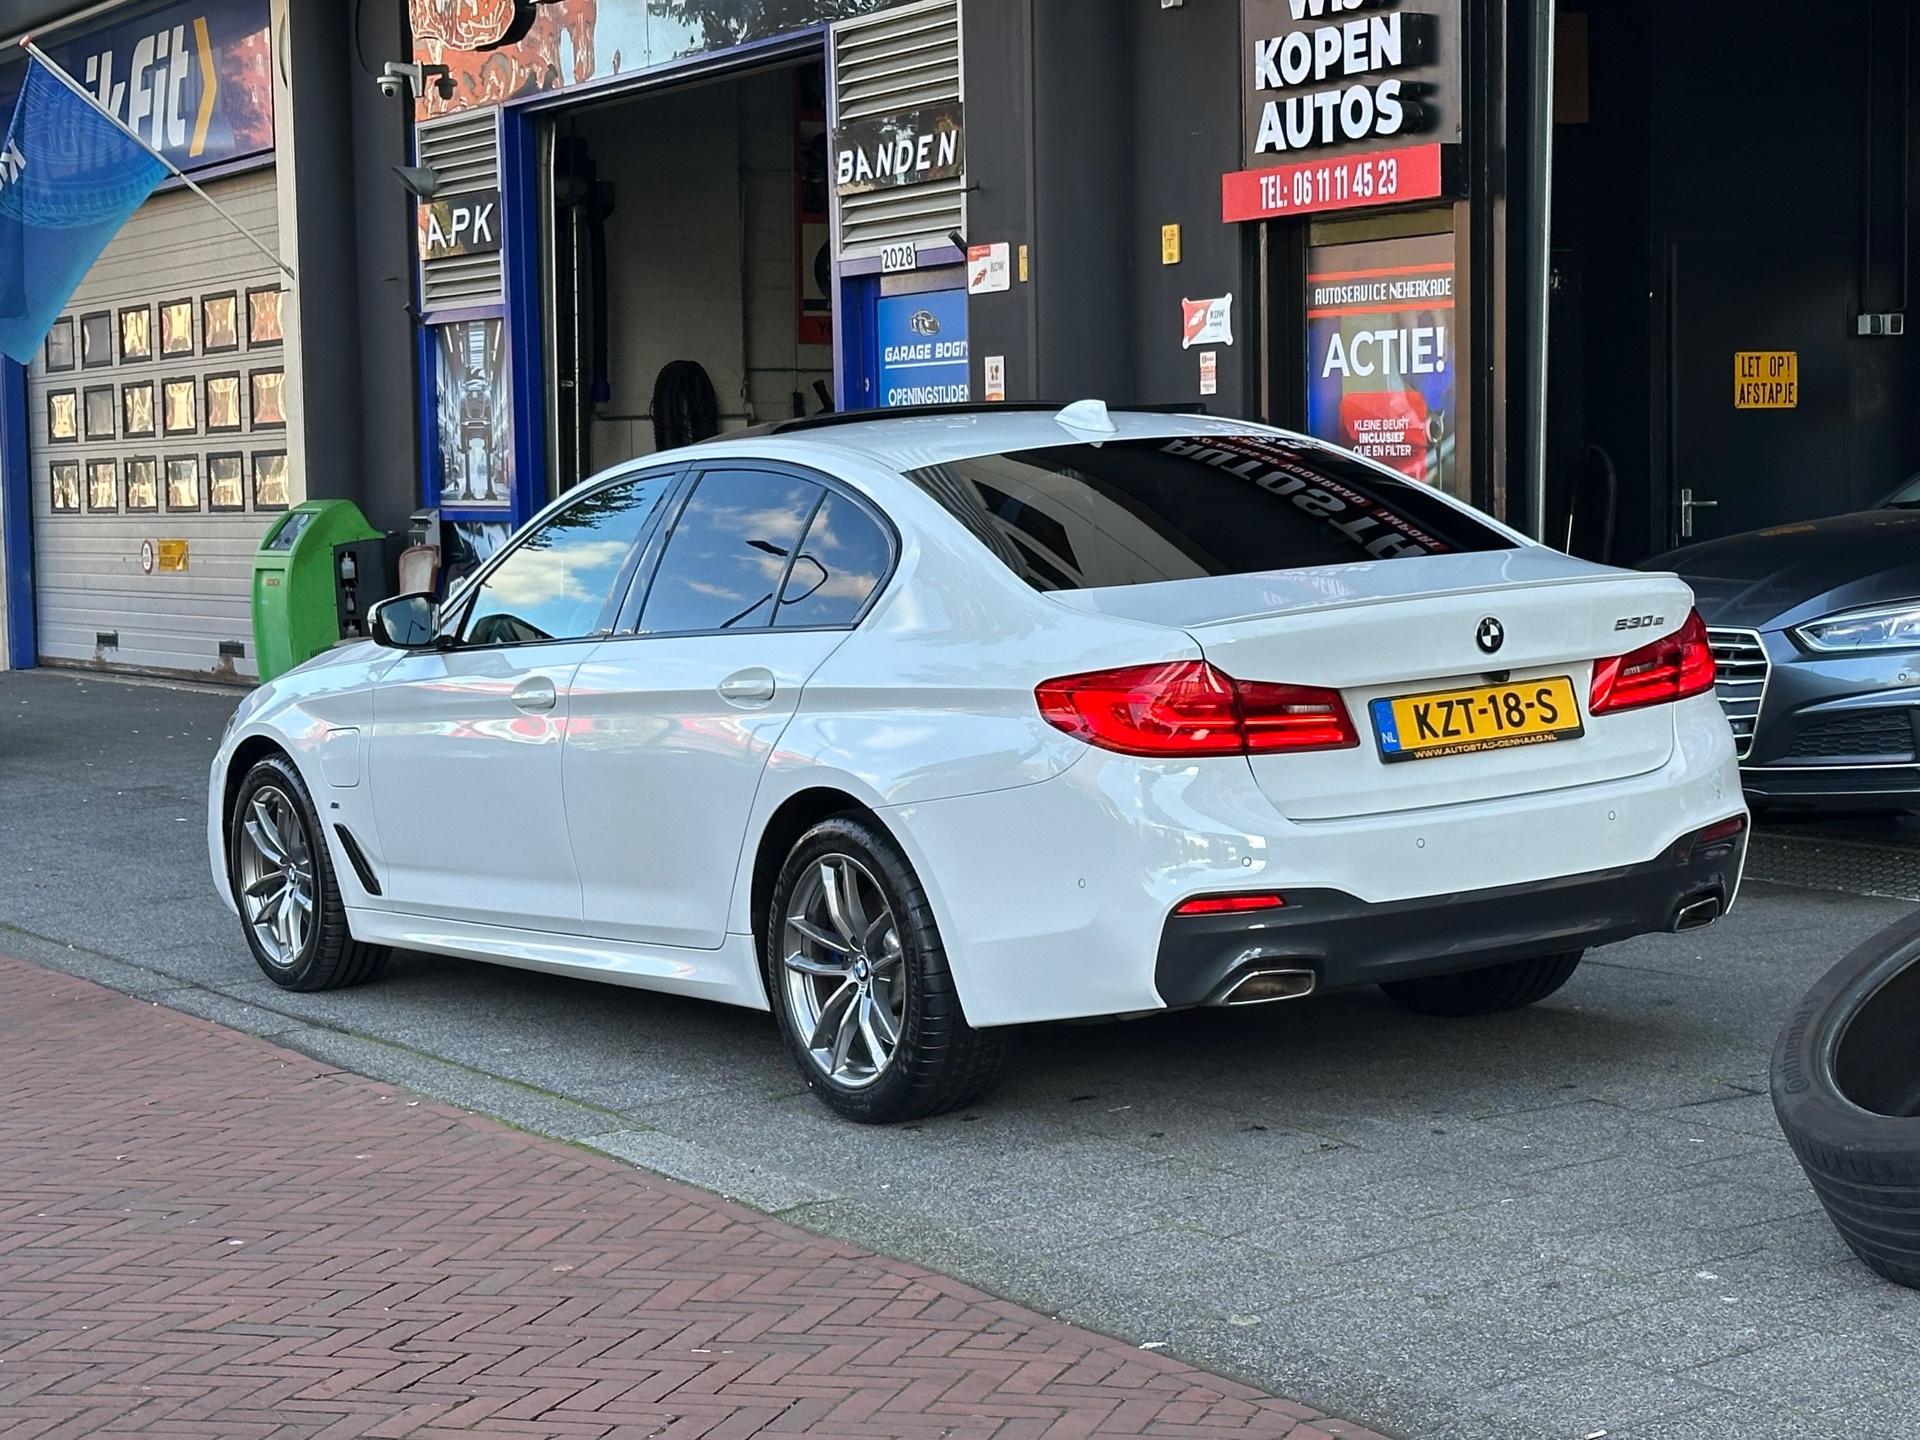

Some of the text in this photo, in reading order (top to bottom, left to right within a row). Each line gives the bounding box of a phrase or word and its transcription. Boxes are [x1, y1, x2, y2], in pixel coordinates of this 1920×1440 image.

[1255, 12, 1402, 91] KOPEN
[1255, 79, 1403, 154] AUTOS
[837, 129, 958, 185] BANDEN
[1260, 158, 1397, 210] TEL: 06 11 11 45 23
[427, 203, 493, 250] APK
[882, 245, 914, 269] 2028
[1315, 278, 1452, 305] AUTOSERVICE NEHERKADE
[885, 344, 932, 362] GARAGE
[1322, 326, 1445, 378] ACTIE!
[1741, 356, 1790, 377] LET OP!
[1739, 382, 1794, 404] AFSTAPJE
[1354, 419, 1381, 431] KLEINE
[1359, 431, 1405, 444] INCLUSIEF
[1373, 445, 1383, 456] EN
[1385, 445, 1411, 457] FILTER
[1413, 688, 1558, 740] KZT-18-S
[1382, 732, 1397, 745] NL
[1414, 733, 1557, 759] WWW.AUTOSTAD-DENHAAG.NL
